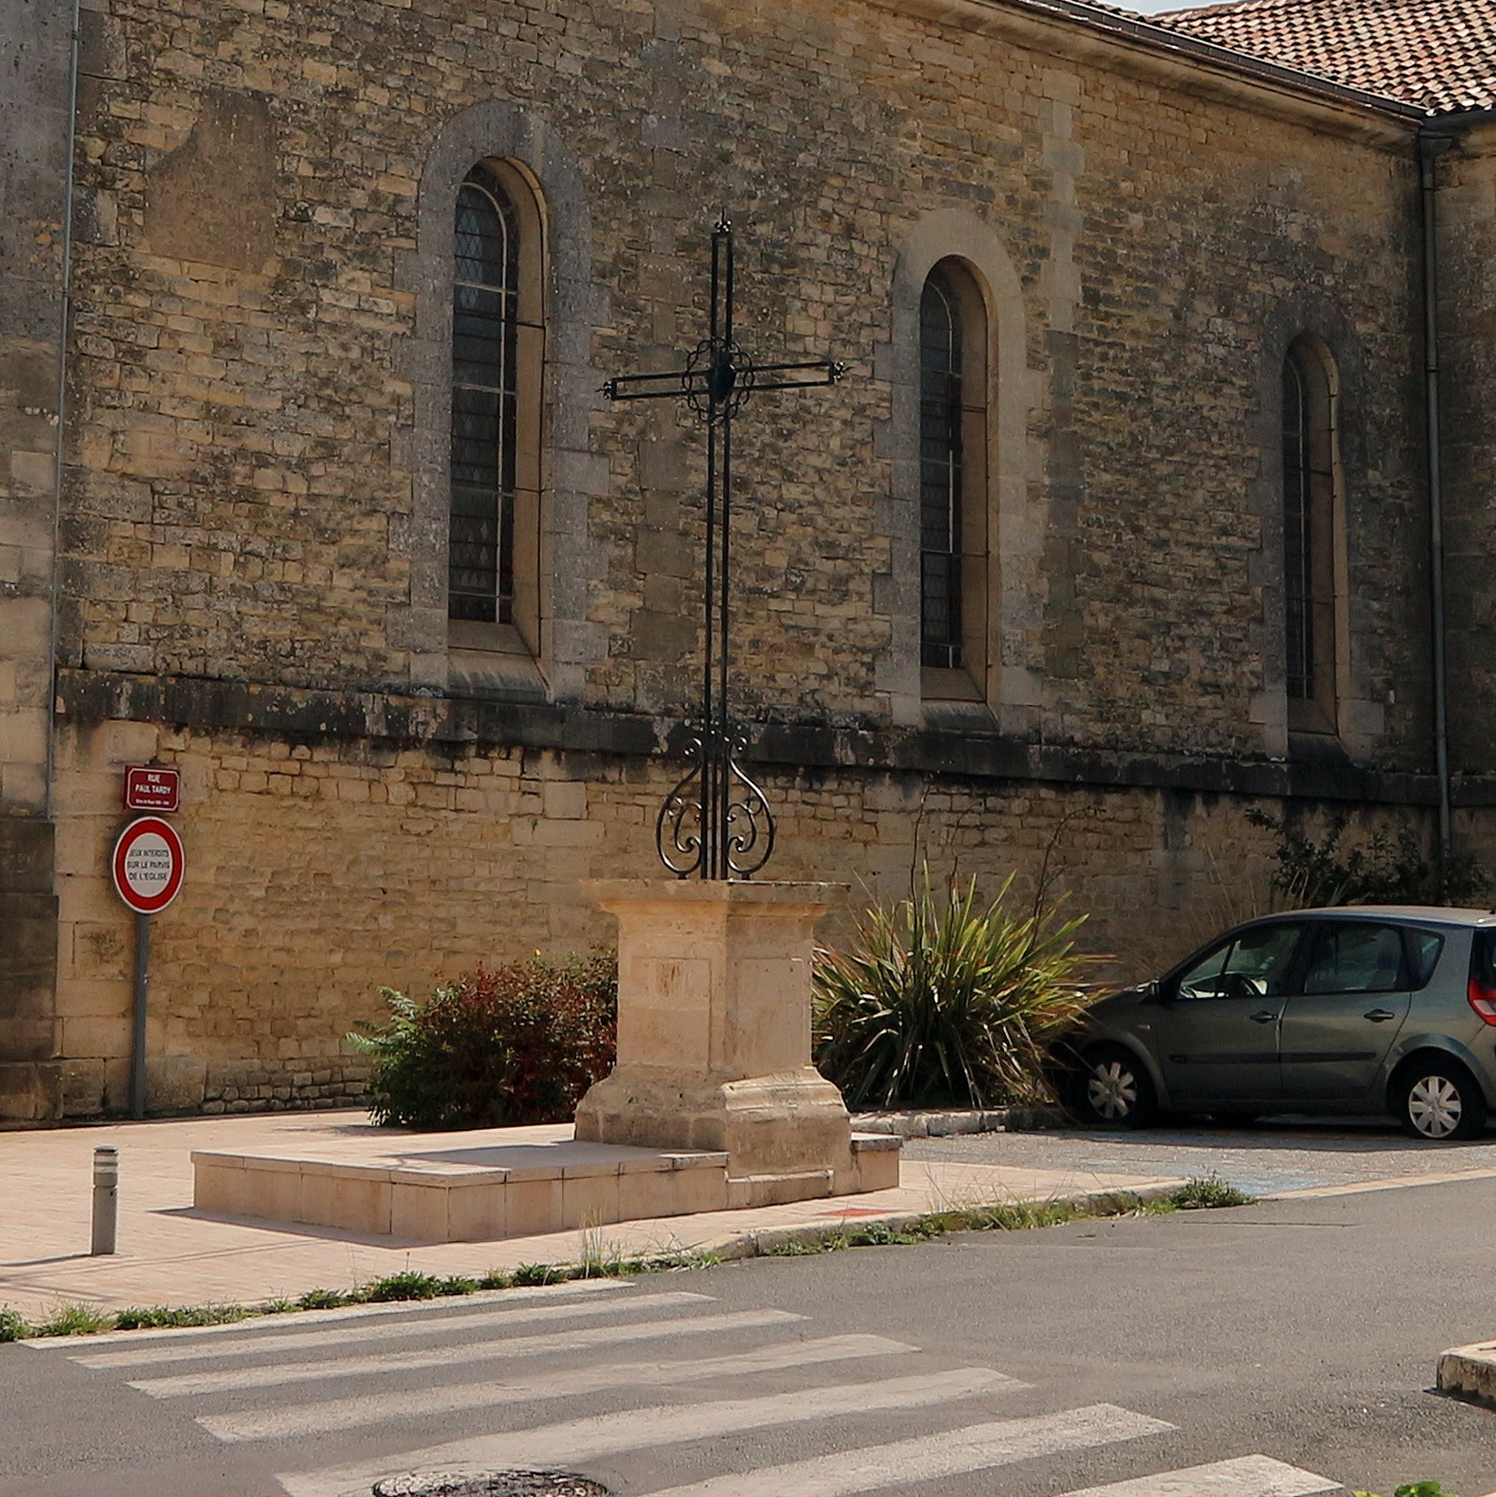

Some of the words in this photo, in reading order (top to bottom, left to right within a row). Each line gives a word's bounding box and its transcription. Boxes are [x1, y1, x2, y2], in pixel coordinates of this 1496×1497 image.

[135, 784, 151, 793] PAUL
[127, 861, 140, 869] SUR
[141, 861, 149, 869] LE
[129, 872, 139, 880] DE
